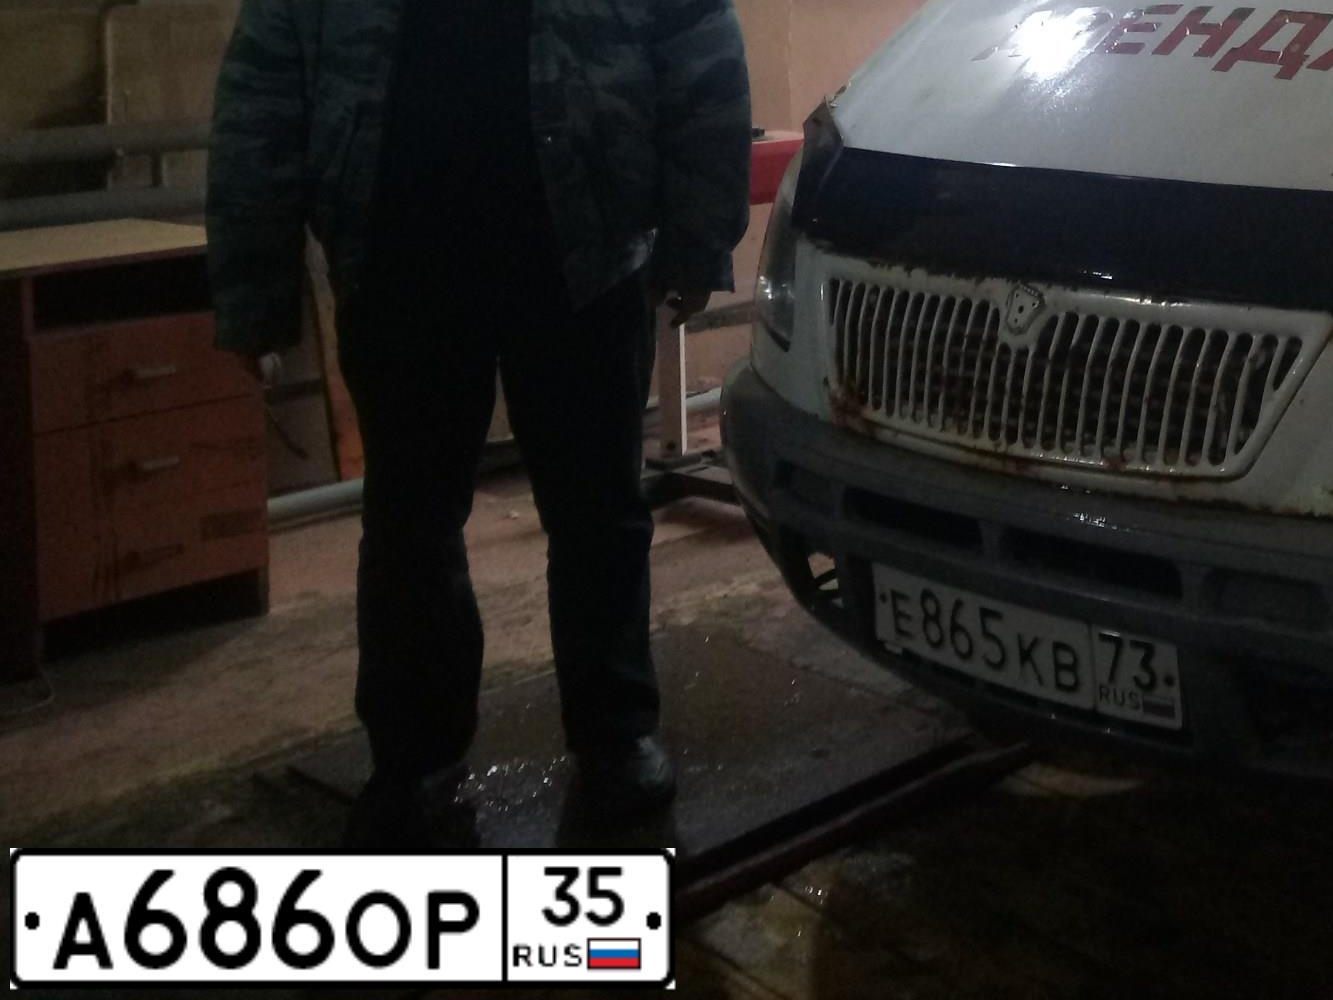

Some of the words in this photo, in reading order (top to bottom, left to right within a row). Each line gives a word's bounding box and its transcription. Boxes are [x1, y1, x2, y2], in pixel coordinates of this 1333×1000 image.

[890, 588, 1080, 693] Е865КВ
[1099, 632, 1158, 691] 73
[1100, 685, 1142, 711] RUS
